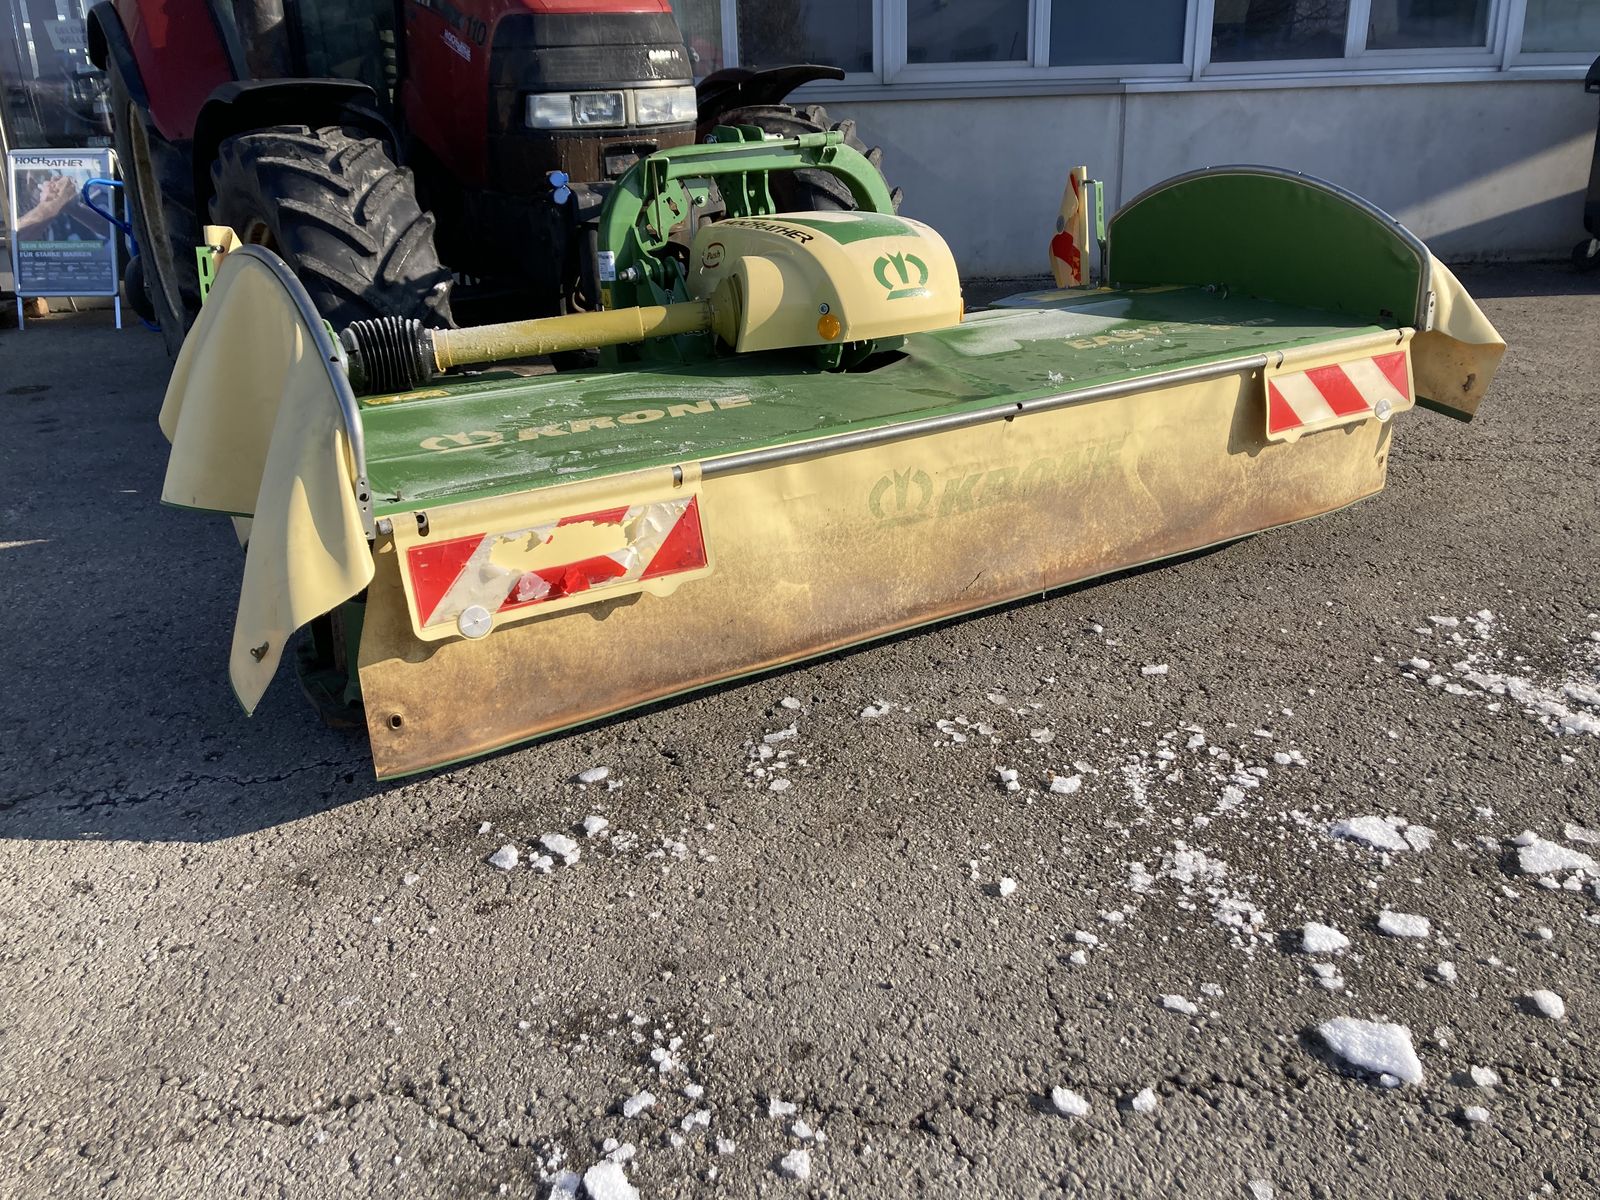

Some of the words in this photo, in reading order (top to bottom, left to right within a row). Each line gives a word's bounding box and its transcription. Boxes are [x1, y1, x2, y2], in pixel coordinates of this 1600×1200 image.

[15, 156, 83, 167] HOCHRATHER
[706, 250, 721, 261] Push
[518, 394, 752, 443] KRONE
